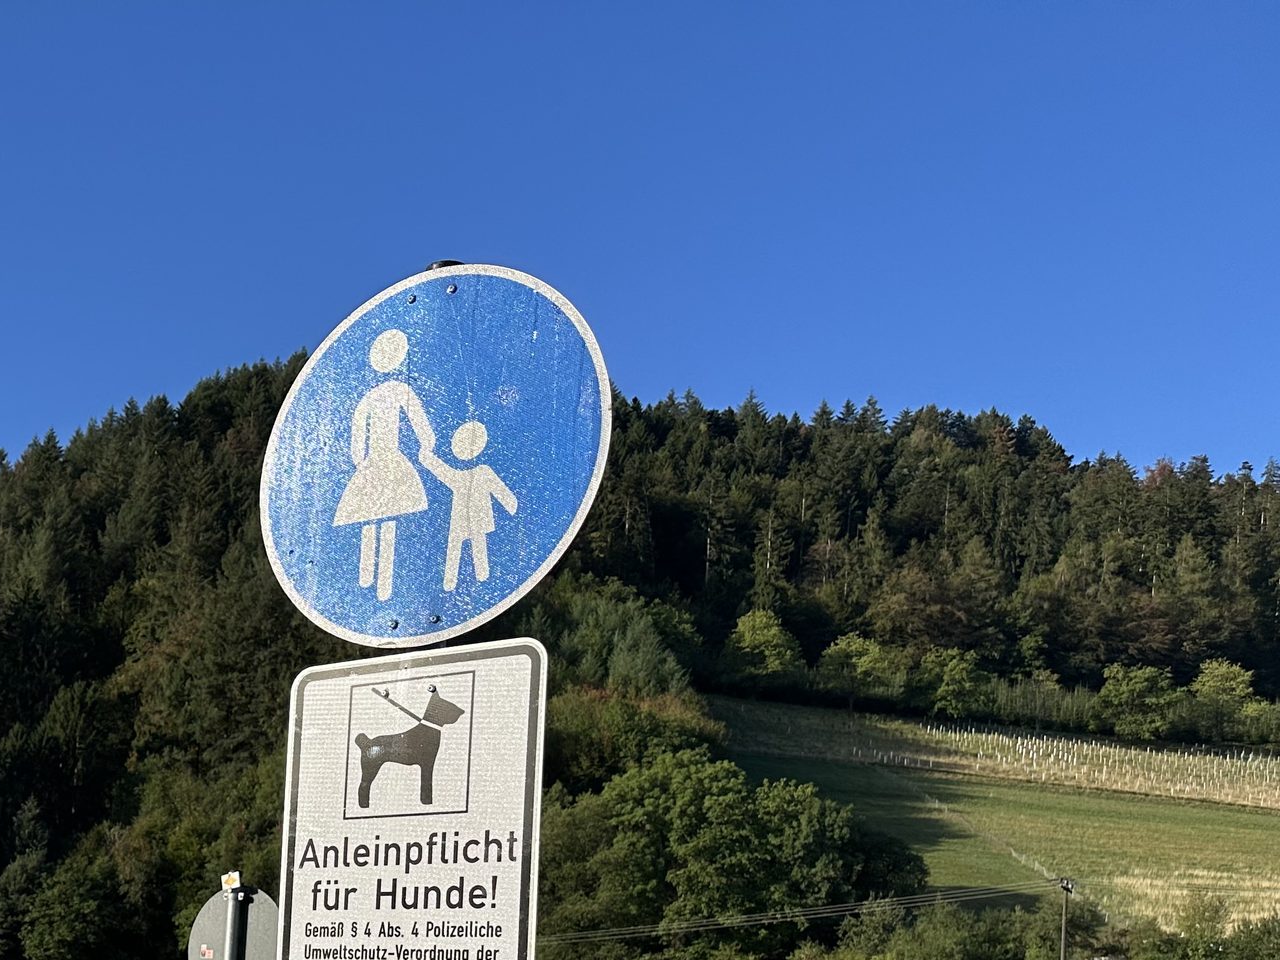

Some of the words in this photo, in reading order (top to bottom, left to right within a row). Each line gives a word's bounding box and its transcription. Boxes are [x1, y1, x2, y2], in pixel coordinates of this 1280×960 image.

[298, 830, 518, 874] Anleinpflicht
[311, 880, 357, 911] für
[375, 875, 498, 910] Hunde!
[304, 922, 344, 938] Gemäß
[350, 921, 358, 938] §
[363, 922, 372, 938] 4
[378, 921, 404, 938] Abs.
[410, 922, 419, 938] 4
[425, 921, 502, 938] Polizeiliche
